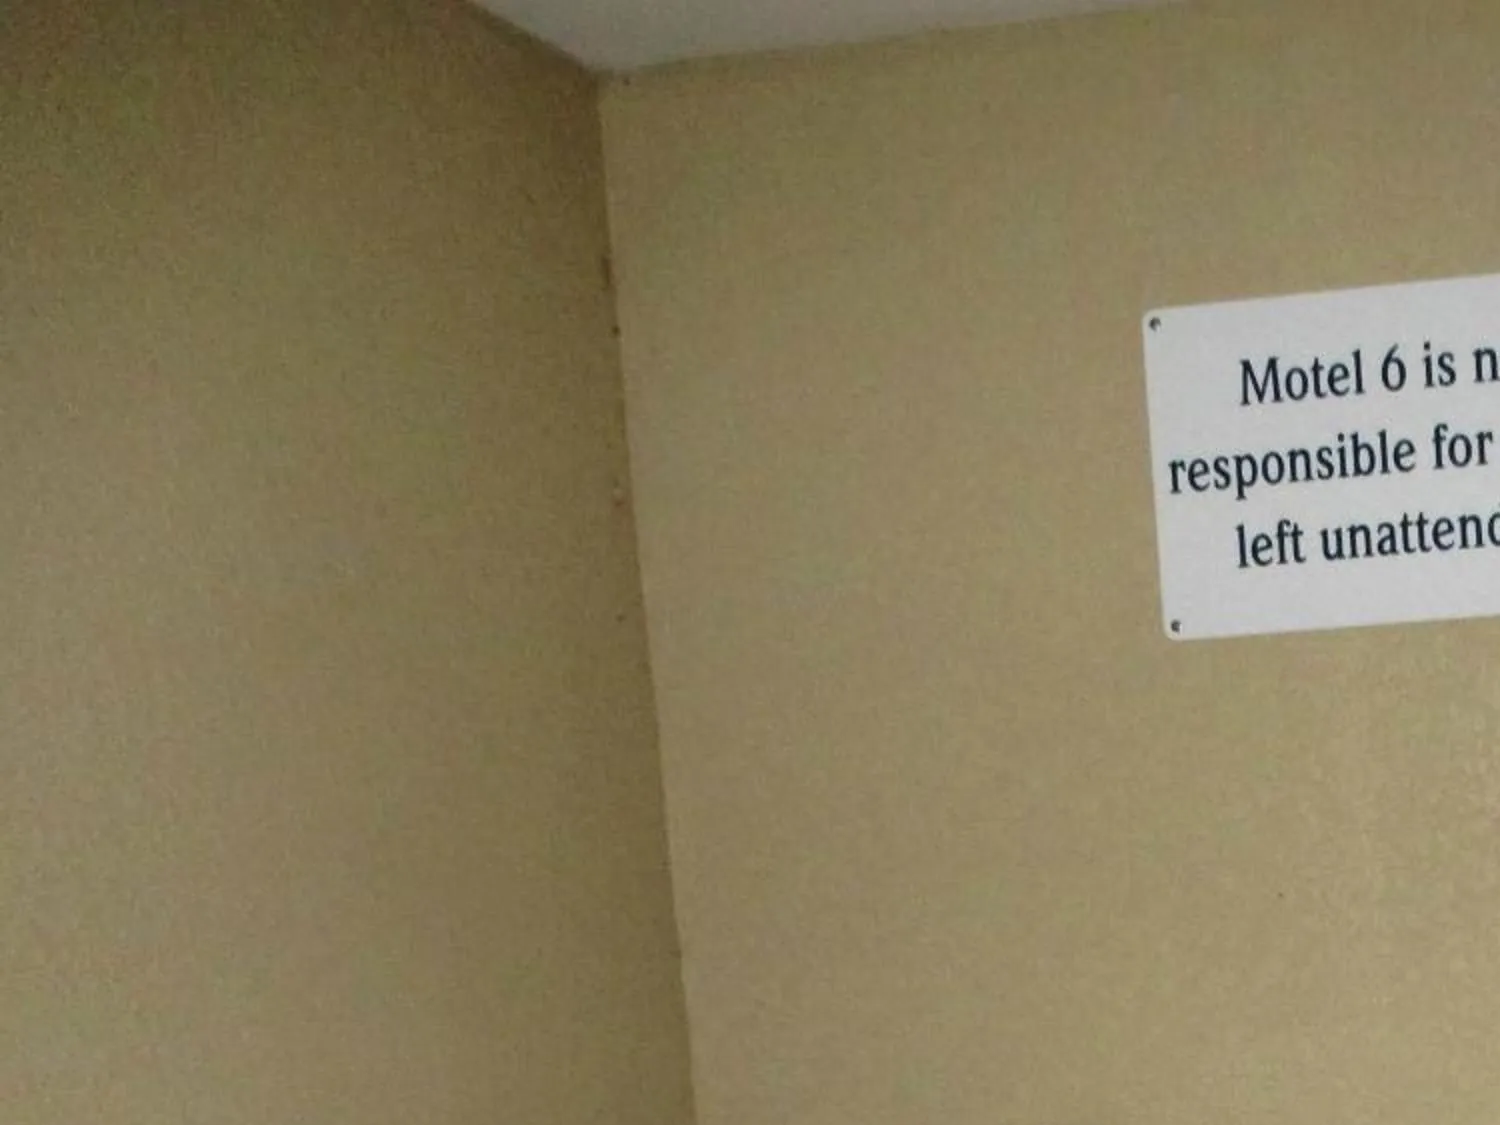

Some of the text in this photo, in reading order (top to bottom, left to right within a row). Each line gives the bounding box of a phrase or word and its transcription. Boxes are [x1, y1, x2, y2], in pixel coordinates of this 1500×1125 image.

[1239, 349, 1364, 406] Motel
[1380, 343, 1407, 393] 6
[1422, 341, 1457, 388] is
[1167, 429, 1417, 500] responsible
[1432, 423, 1494, 471] for
[1235, 518, 1307, 569] left
